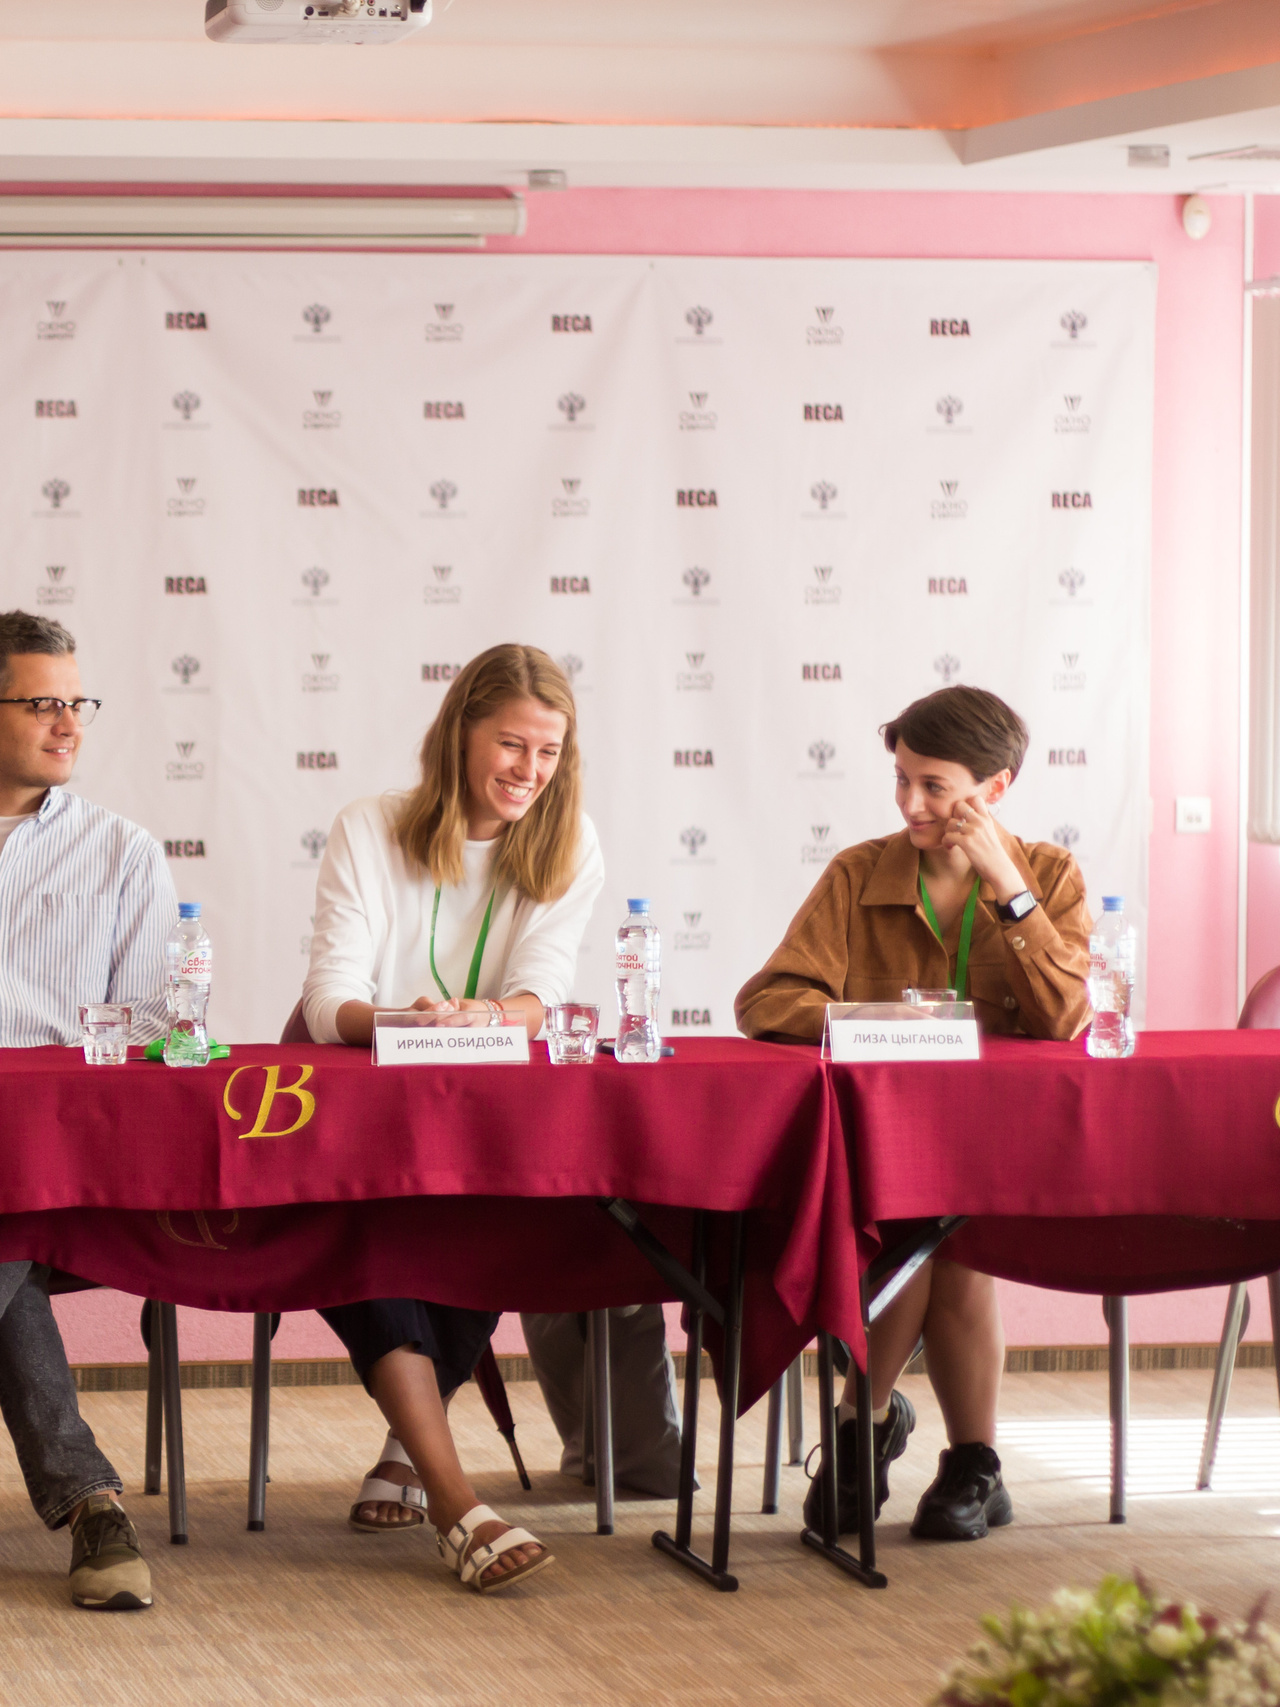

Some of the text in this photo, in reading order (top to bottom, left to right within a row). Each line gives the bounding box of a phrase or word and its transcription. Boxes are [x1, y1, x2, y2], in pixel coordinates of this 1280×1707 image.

[166, 311, 208, 331] RECA
[551, 314, 592, 333] RECA
[930, 319, 970, 337] RECA
[35, 399, 78, 418] RECA
[423, 401, 465, 420] RECA
[803, 403, 844, 422] RECA
[298, 488, 340, 507] RECA
[676, 489, 718, 508] RECA
[1051, 491, 1092, 509] RECA
[165, 576, 207, 595] RECA
[550, 576, 591, 594] RECA
[927, 577, 968, 595] RECA
[802, 663, 842, 681] RECA
[296, 751, 338, 771] RECA
[674, 749, 714, 767] RECA
[1048, 748, 1087, 766] RECA
[164, 840, 206, 858] RECA
[671, 1008, 712, 1026] RECA
[397, 1037, 513, 1049] ИРИНА ОБИДОВА
[854, 1034, 963, 1045] ЛИЗА ЦЫГАНОВА
